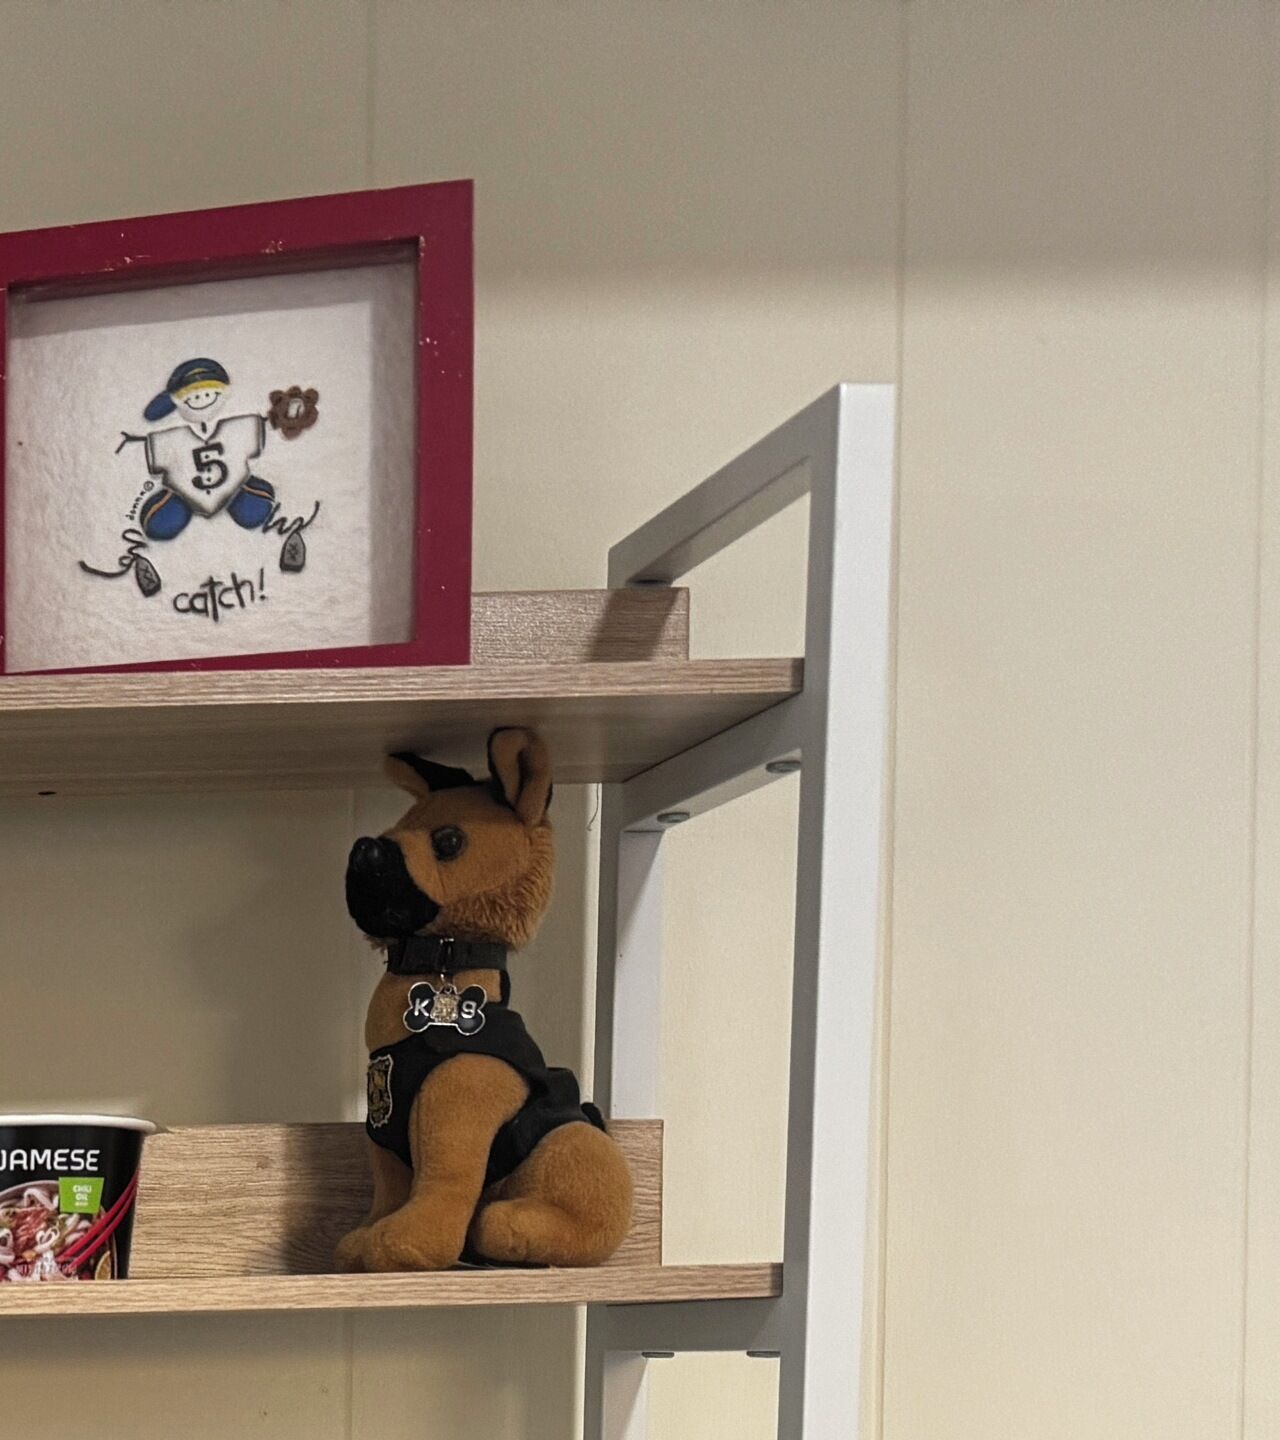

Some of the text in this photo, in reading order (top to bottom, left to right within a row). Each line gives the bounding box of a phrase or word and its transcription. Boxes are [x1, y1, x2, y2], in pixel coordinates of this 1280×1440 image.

[192, 443, 228, 489] 5
[173, 567, 267, 622] catch!
[414, 998, 429, 1016] K
